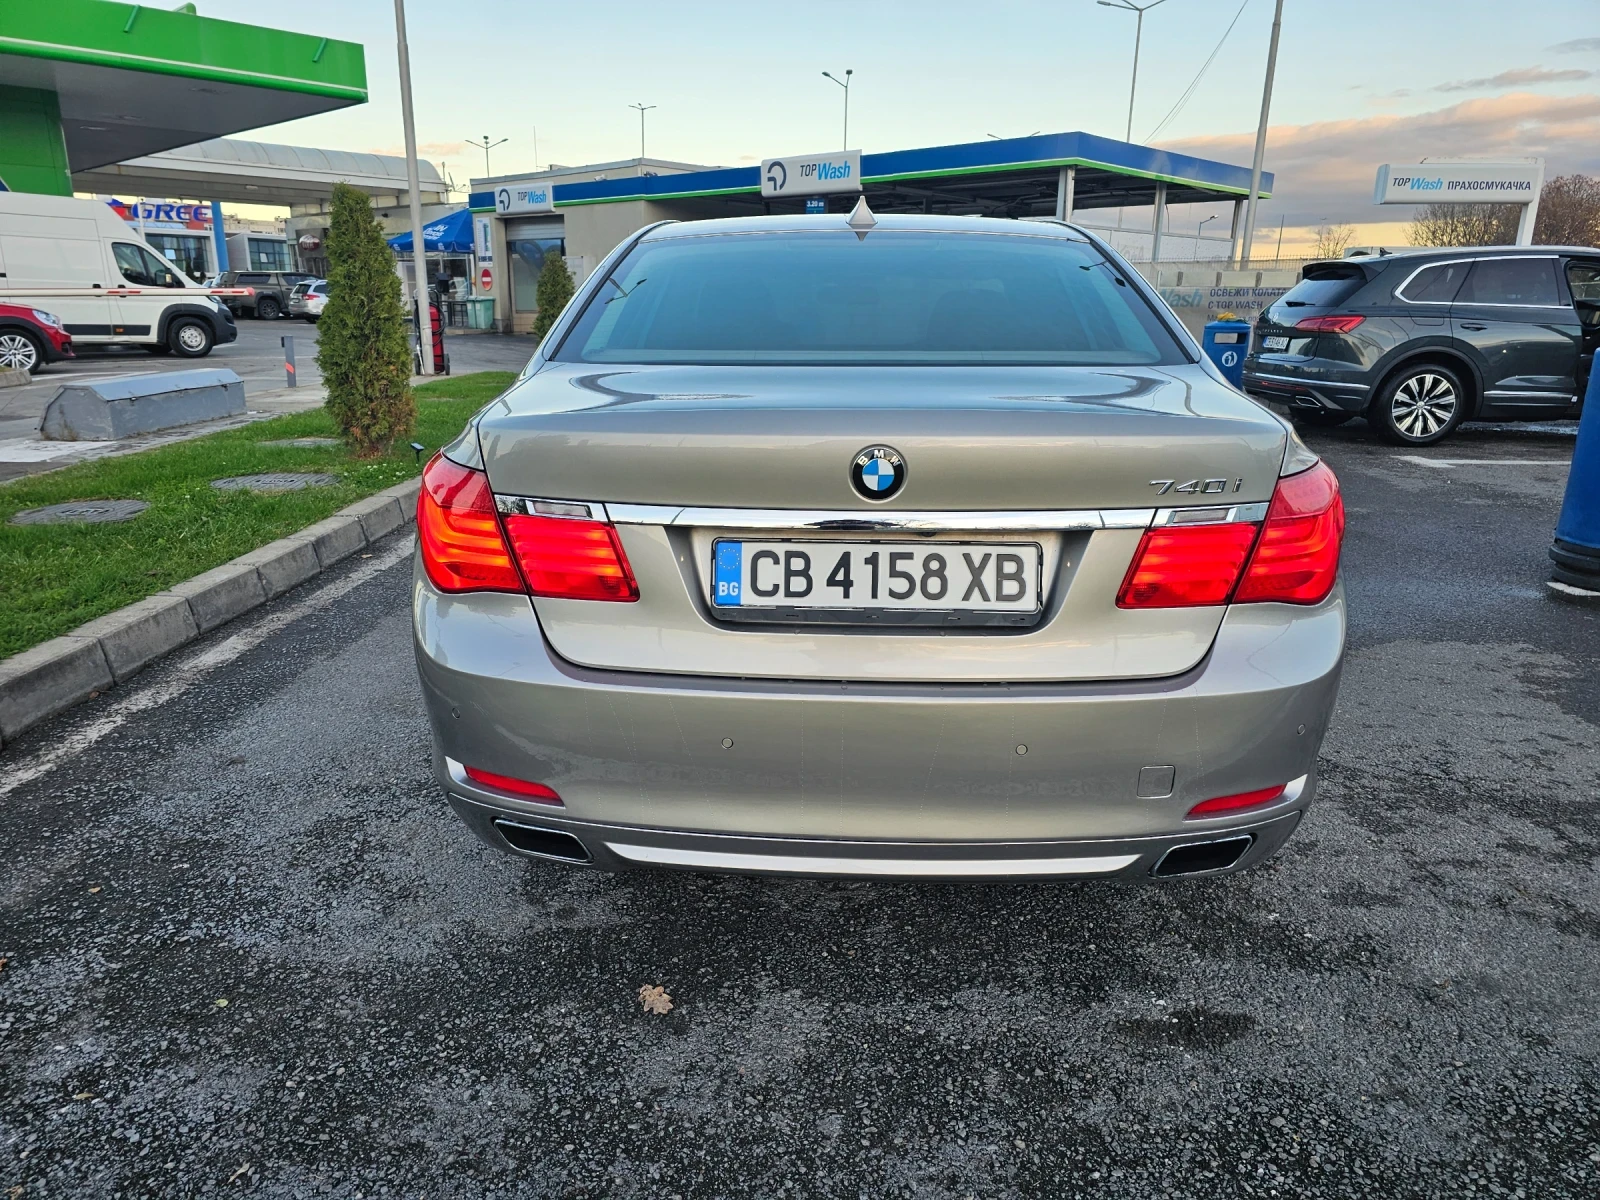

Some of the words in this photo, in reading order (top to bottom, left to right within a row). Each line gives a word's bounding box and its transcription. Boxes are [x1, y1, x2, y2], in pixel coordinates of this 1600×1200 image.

[1448, 181, 1531, 190] ПРАХОСМУКАЧКА
[132, 203, 211, 222] GREE
[1210, 288, 1249, 297] ОСВЕЖИ
[1235, 301, 1263, 309] WASH
[858, 449, 901, 467] BMW
[749, 550, 813, 598] CB
[826, 551, 948, 600] 4158
[961, 552, 1026, 601] XB
[718, 582, 739, 596] BG
